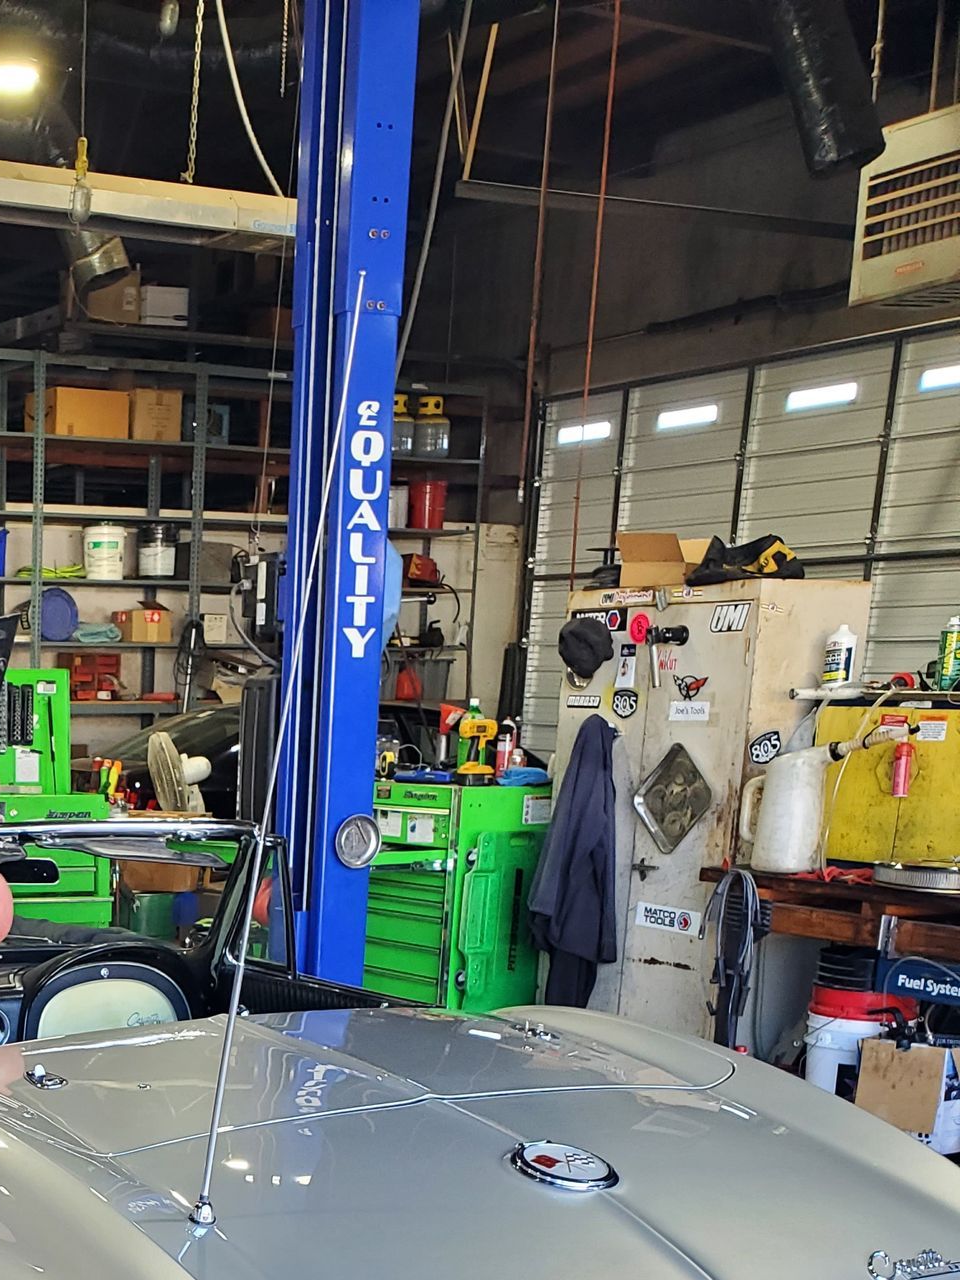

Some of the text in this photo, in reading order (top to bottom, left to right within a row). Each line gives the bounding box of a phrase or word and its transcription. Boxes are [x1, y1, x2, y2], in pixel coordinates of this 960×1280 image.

[343, 430, 385, 658] QUALITY
[711, 603, 751, 633] UMI
[614, 695, 638, 711] 805
[675, 706, 706, 716] Joe's Tools
[751, 734, 781, 762] 805
[644, 906, 677, 920] MATCO
[644, 915, 675, 928] TOOLS
[897, 974, 925, 991] Fuel
